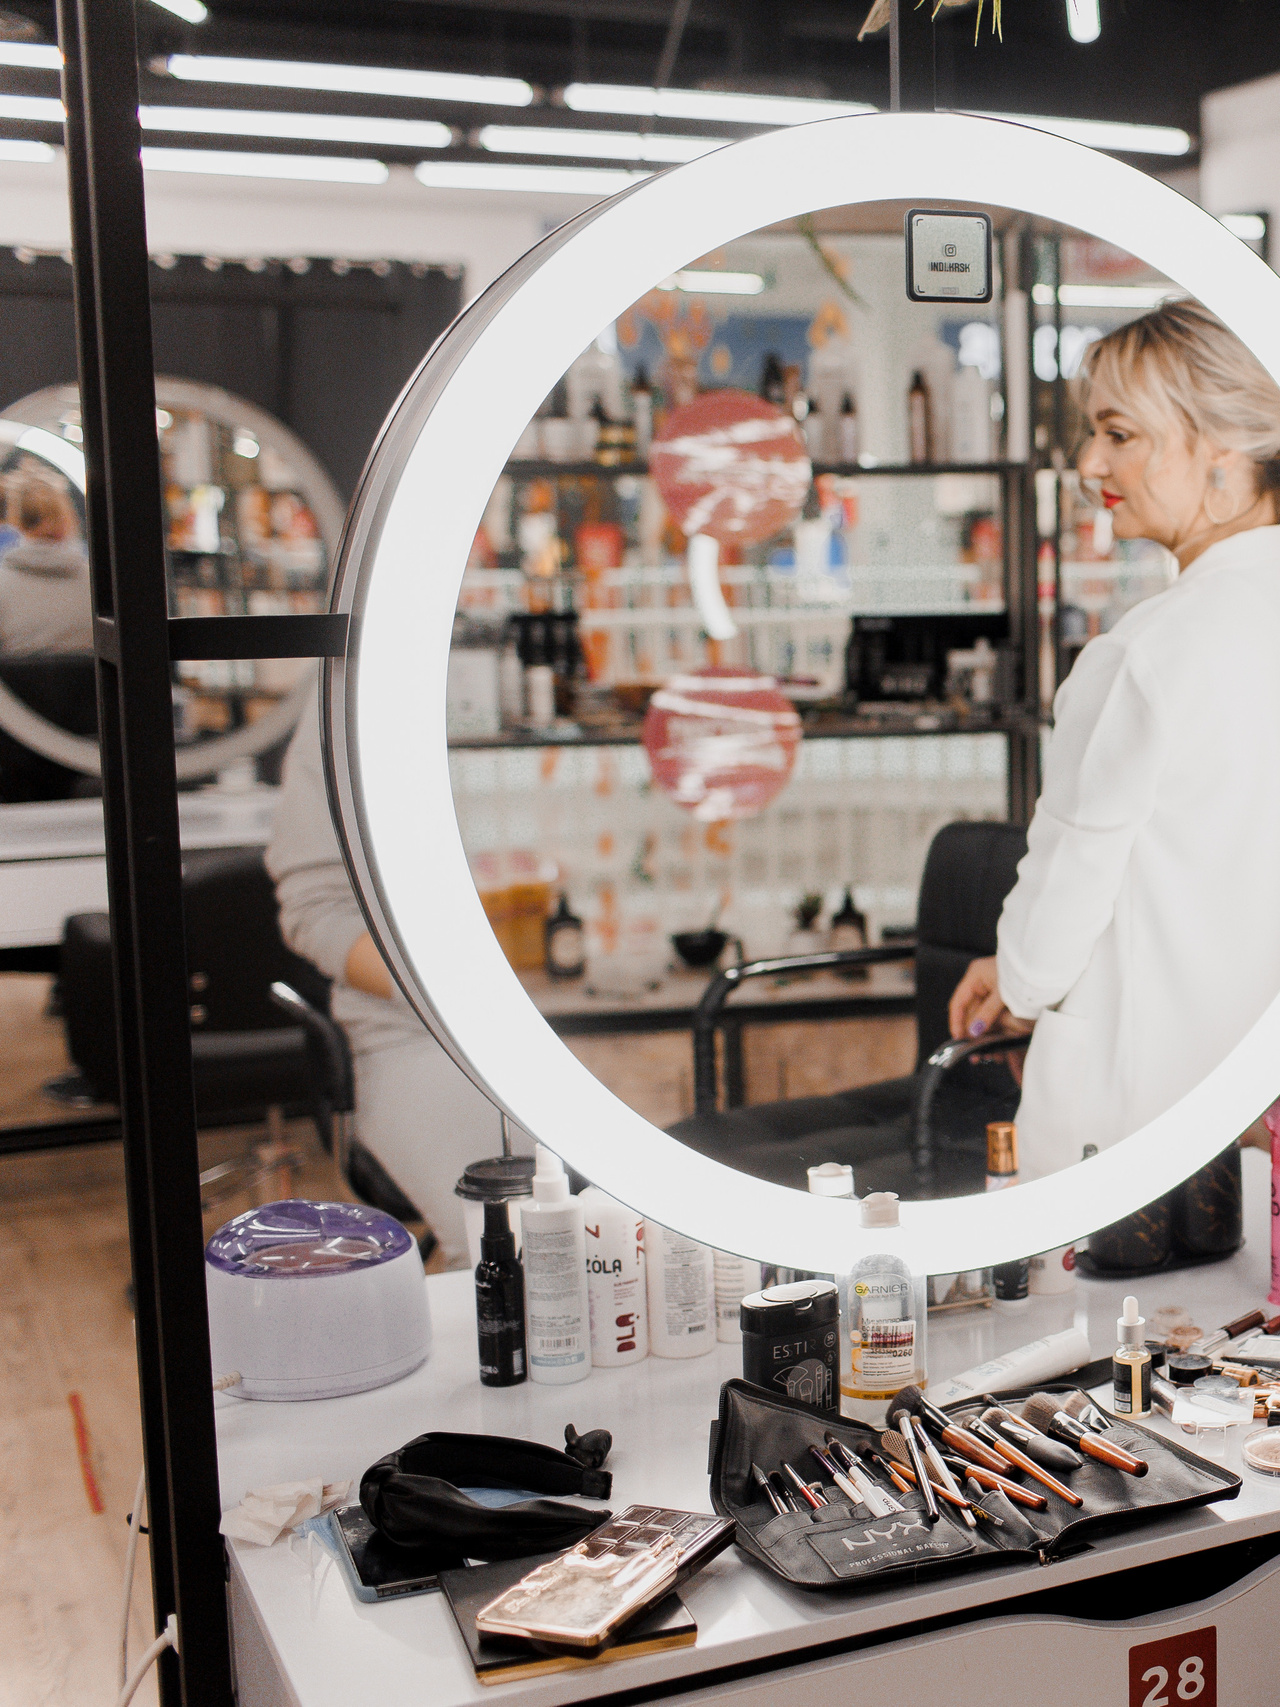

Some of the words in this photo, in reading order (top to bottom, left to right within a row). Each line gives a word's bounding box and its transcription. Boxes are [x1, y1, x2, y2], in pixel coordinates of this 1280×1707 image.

[854, 1282, 908, 1294] GARNIER
[841, 1518, 931, 1551] NYX
[849, 1546, 915, 1568] PROFESSIONAL
[1141, 1655, 1205, 1707] 28
